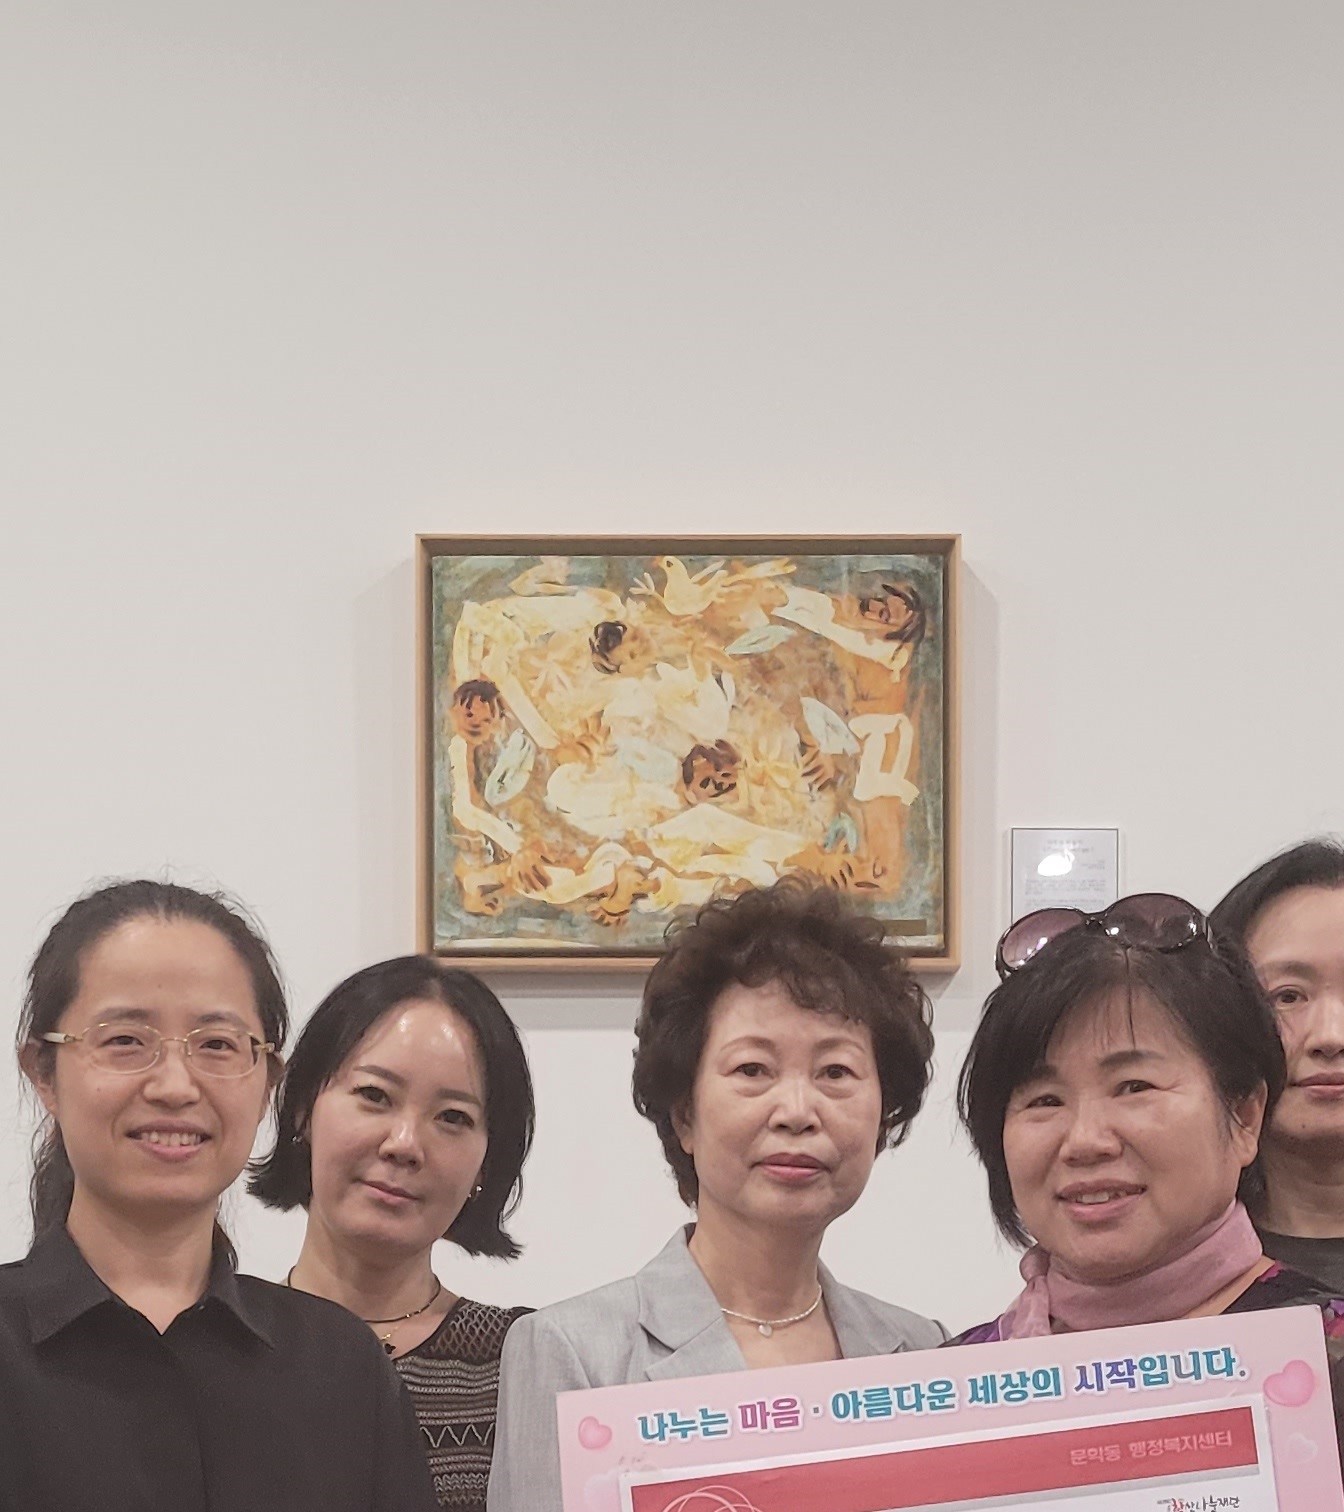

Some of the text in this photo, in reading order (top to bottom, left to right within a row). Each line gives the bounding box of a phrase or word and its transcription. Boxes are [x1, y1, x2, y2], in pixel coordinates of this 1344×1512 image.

[638, 1347, 1246, 1441] 나누는 마음 아름다운 세상의 시작입니다.
[1070, 1430, 1233, 1466] 문학동 행정복지센터
